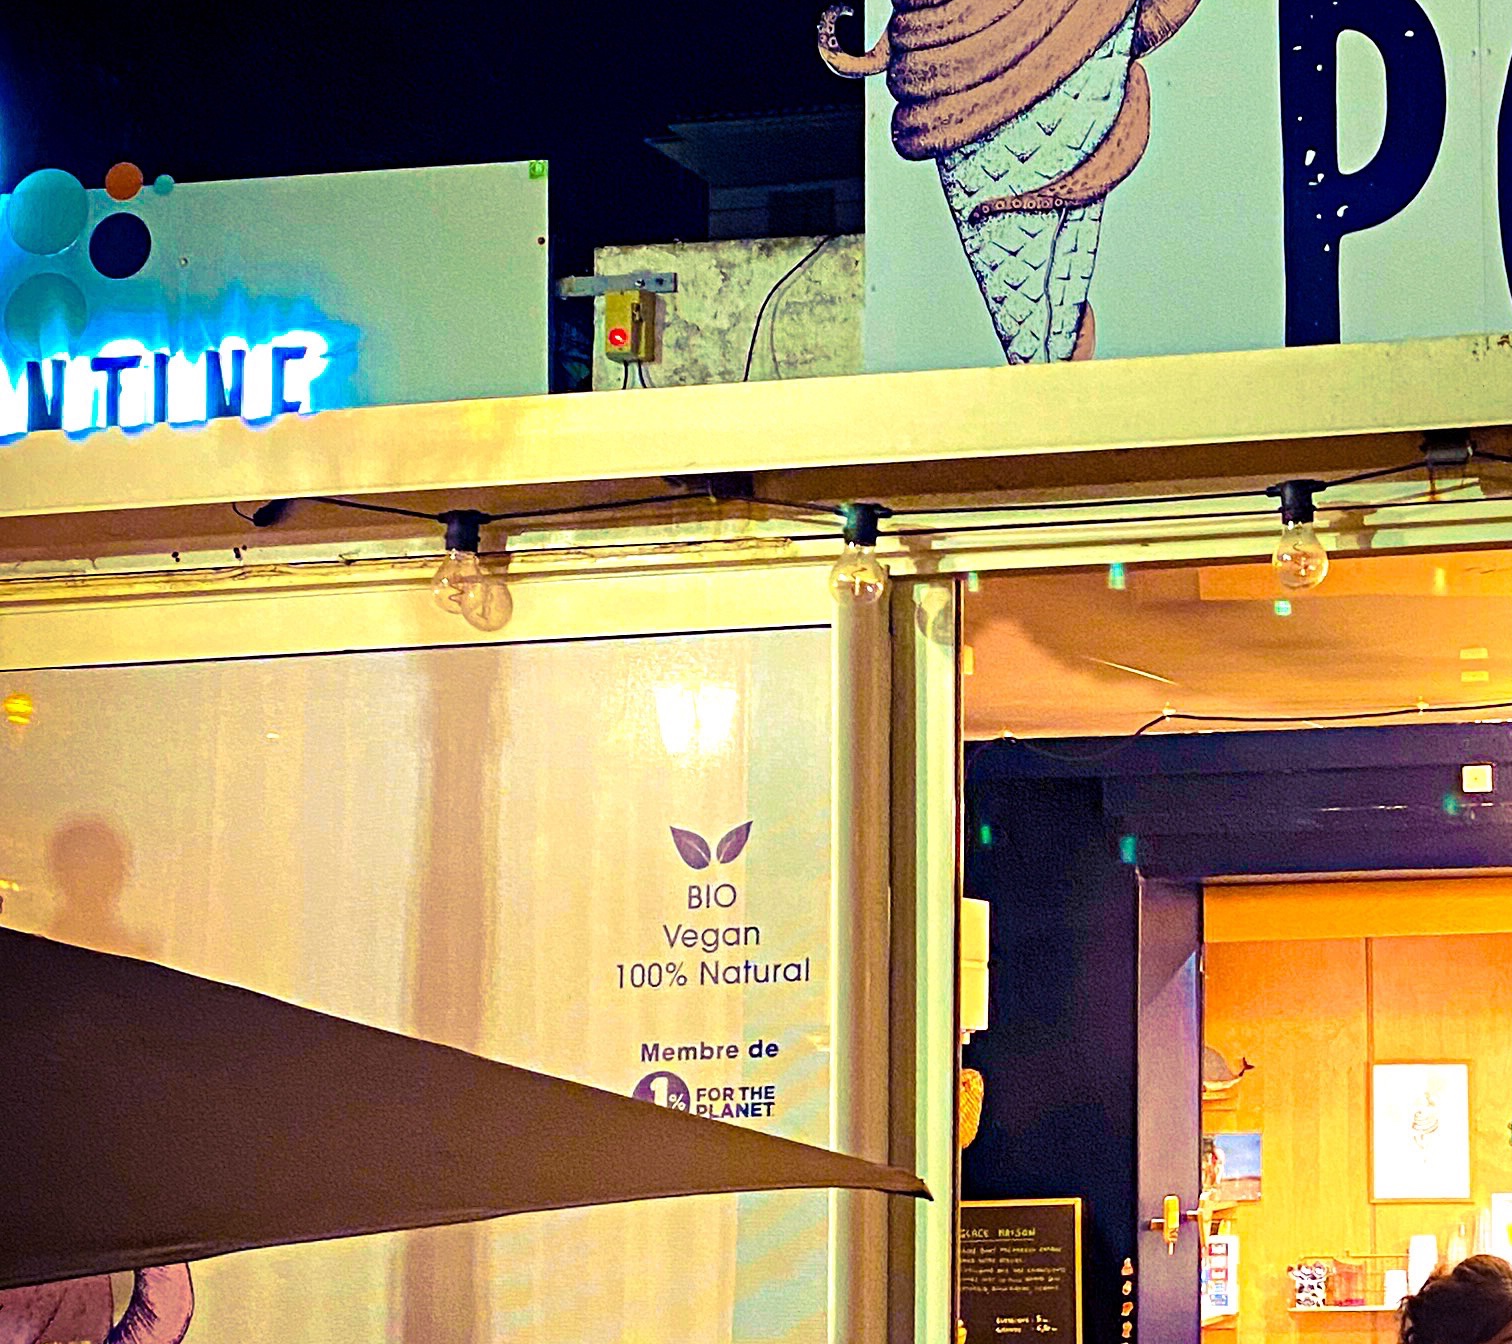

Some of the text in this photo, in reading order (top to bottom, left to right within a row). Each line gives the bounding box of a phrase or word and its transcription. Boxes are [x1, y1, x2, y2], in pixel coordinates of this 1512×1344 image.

[687, 883, 737, 909] BIO
[663, 924, 760, 953] Vegan
[616, 957, 810, 989] 100% Natural
[641, 1040, 779, 1062] Membre de
[696, 1087, 734, 1102] FOR
[739, 1086, 775, 1101] THE
[696, 1102, 776, 1119] PLANET
